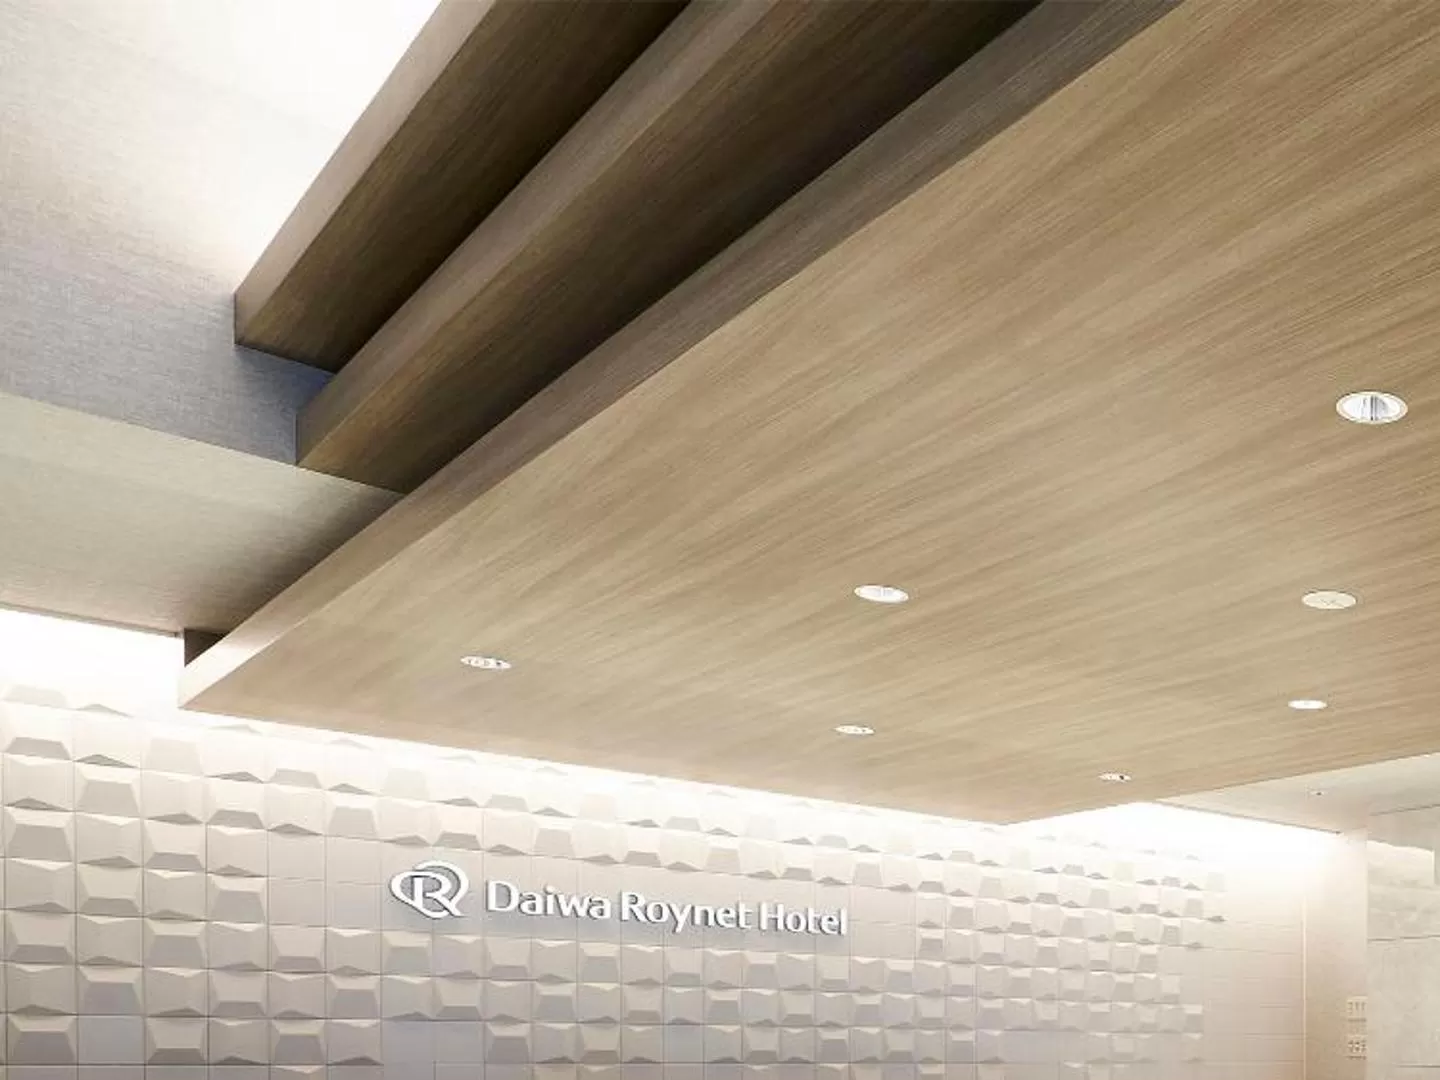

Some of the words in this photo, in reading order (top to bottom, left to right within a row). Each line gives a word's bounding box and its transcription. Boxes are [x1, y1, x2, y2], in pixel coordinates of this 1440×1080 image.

[487, 880, 611, 919] Daiwa
[620, 891, 753, 934] Roynet
[759, 901, 848, 936] Hotel
